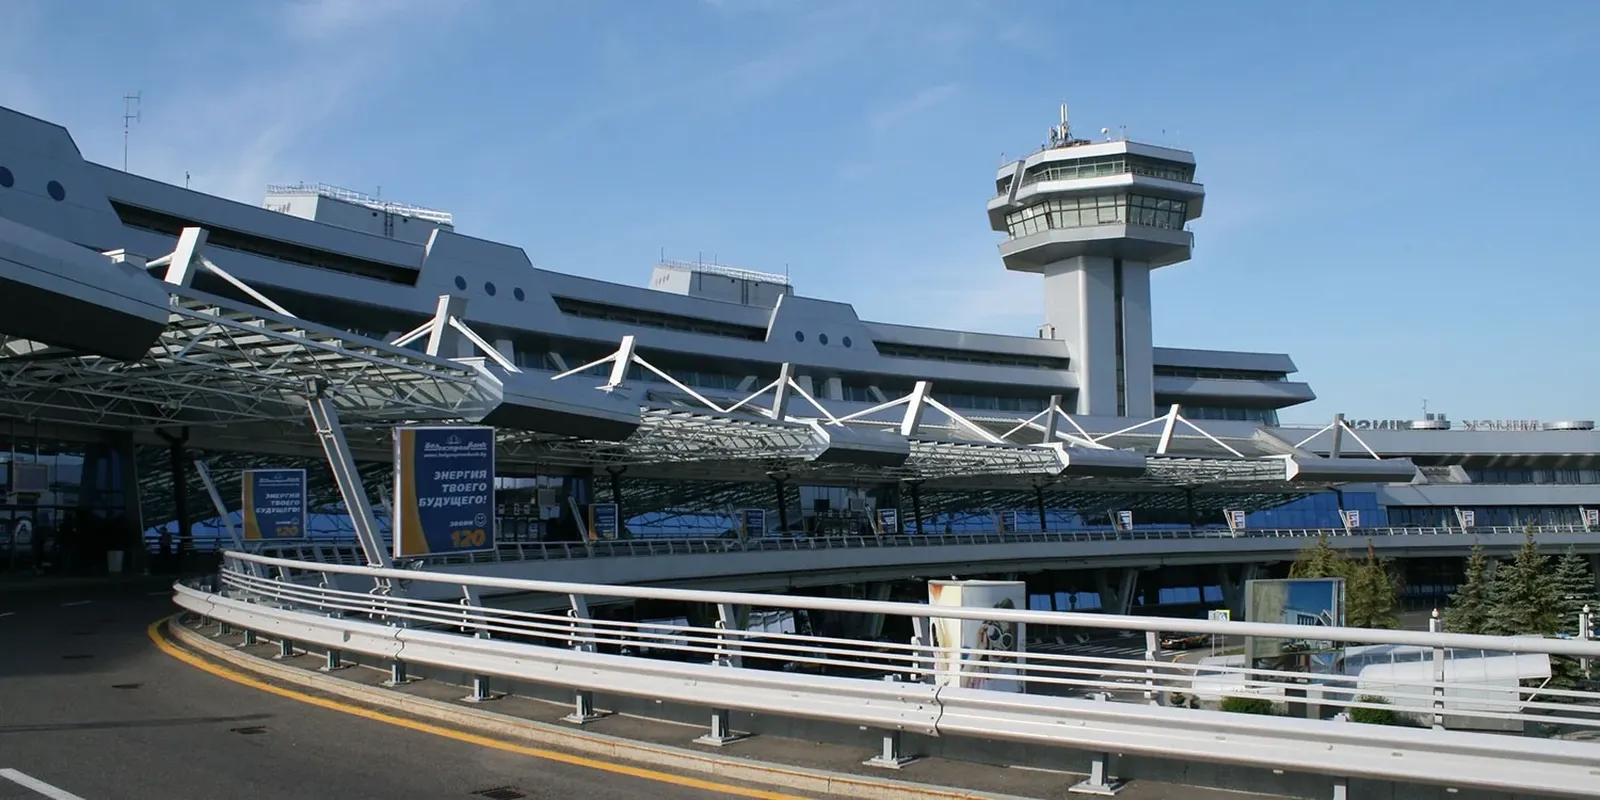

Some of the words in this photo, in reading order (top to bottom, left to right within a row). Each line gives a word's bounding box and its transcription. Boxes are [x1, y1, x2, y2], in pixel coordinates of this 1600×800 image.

[433, 470, 487, 480] ЭНЕРГИЯ
[441, 482, 487, 493] ТВОЕГО
[419, 495, 487, 508] БУДУЩЕГО!
[451, 529, 486, 547] 120
